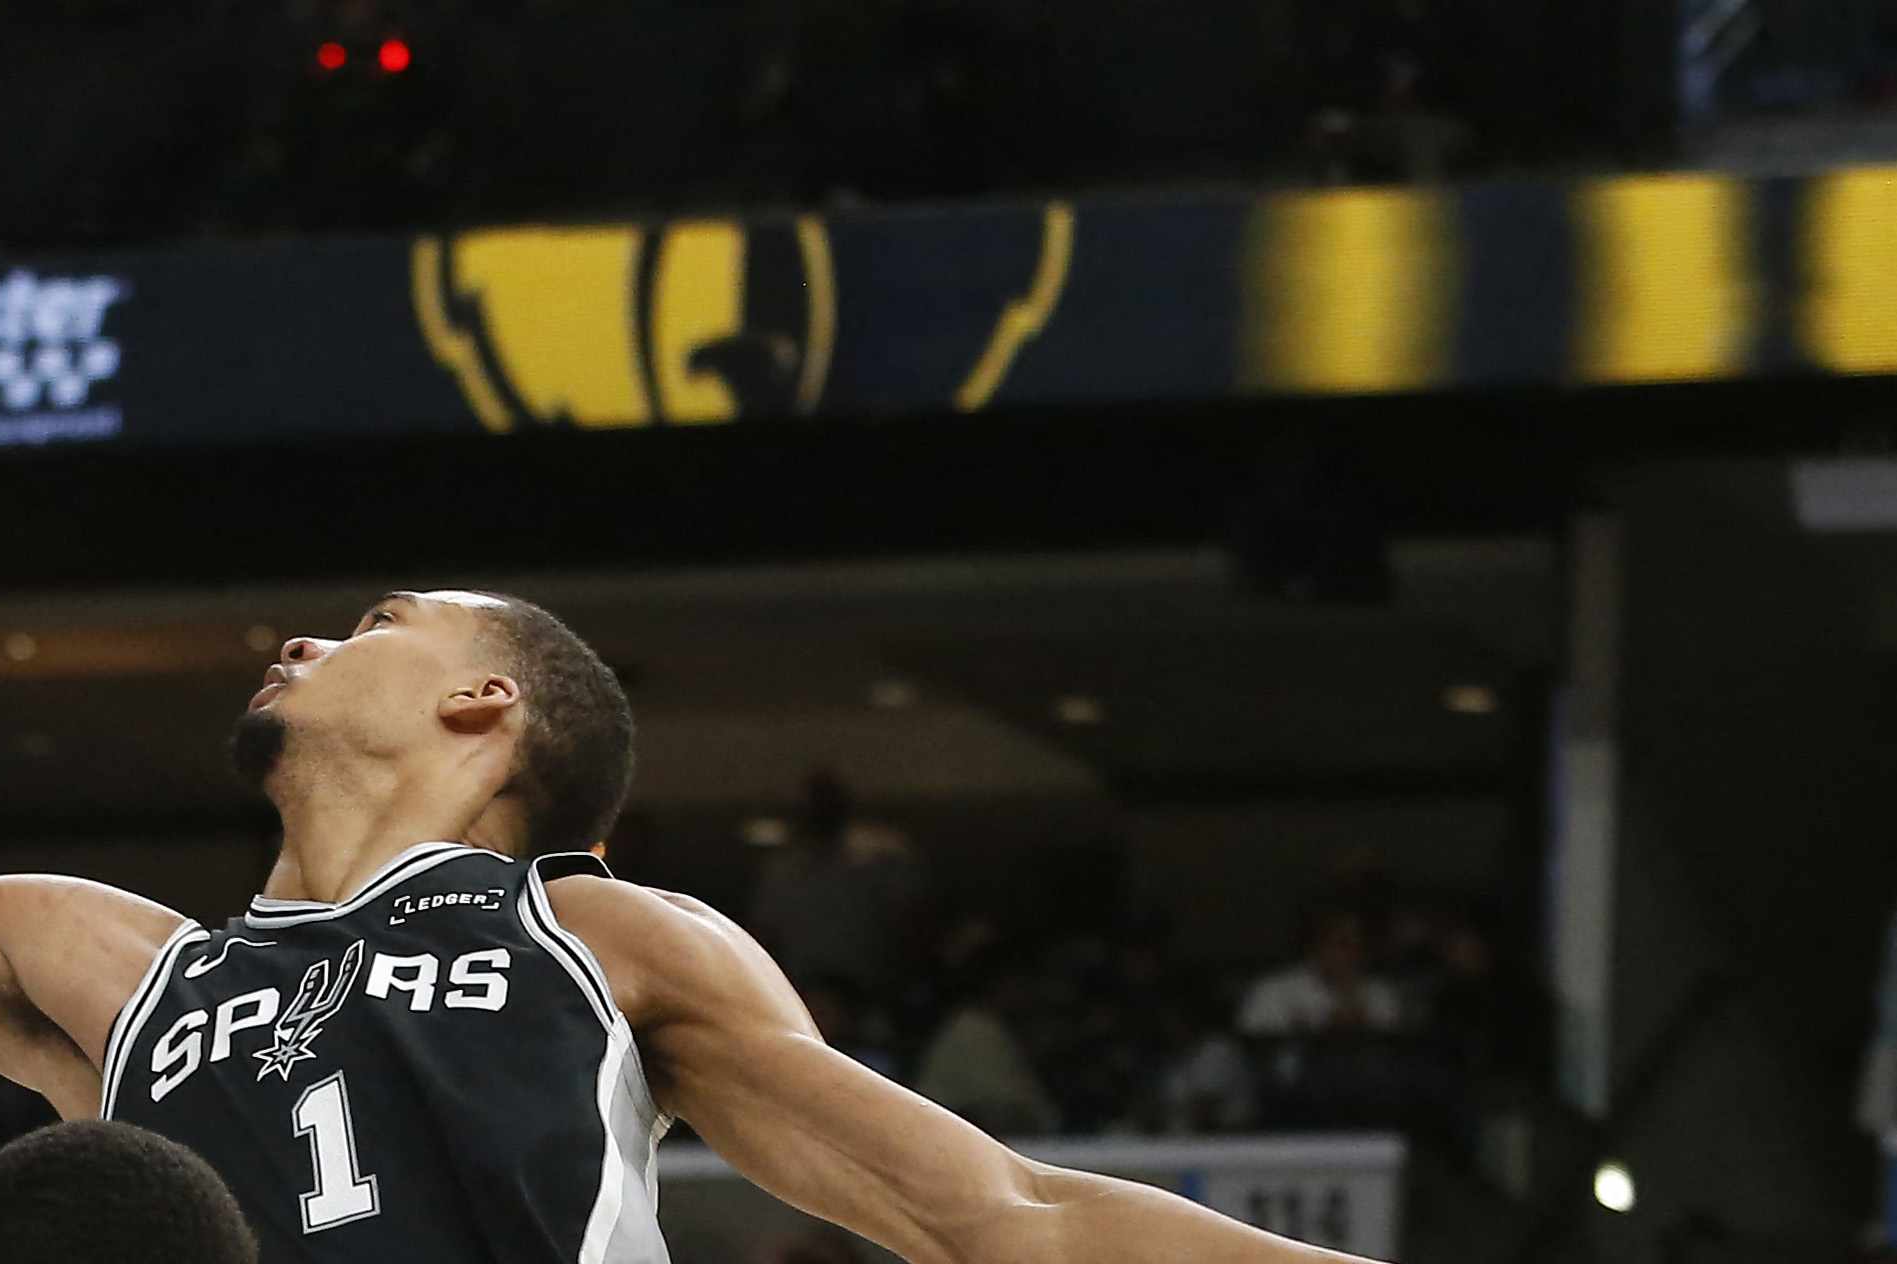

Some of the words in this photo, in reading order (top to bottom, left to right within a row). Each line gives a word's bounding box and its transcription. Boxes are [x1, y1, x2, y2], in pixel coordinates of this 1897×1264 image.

[403, 892, 488, 915] LEDGER
[150, 938, 513, 1103] SPURS
[291, 1068, 382, 1235] 1
